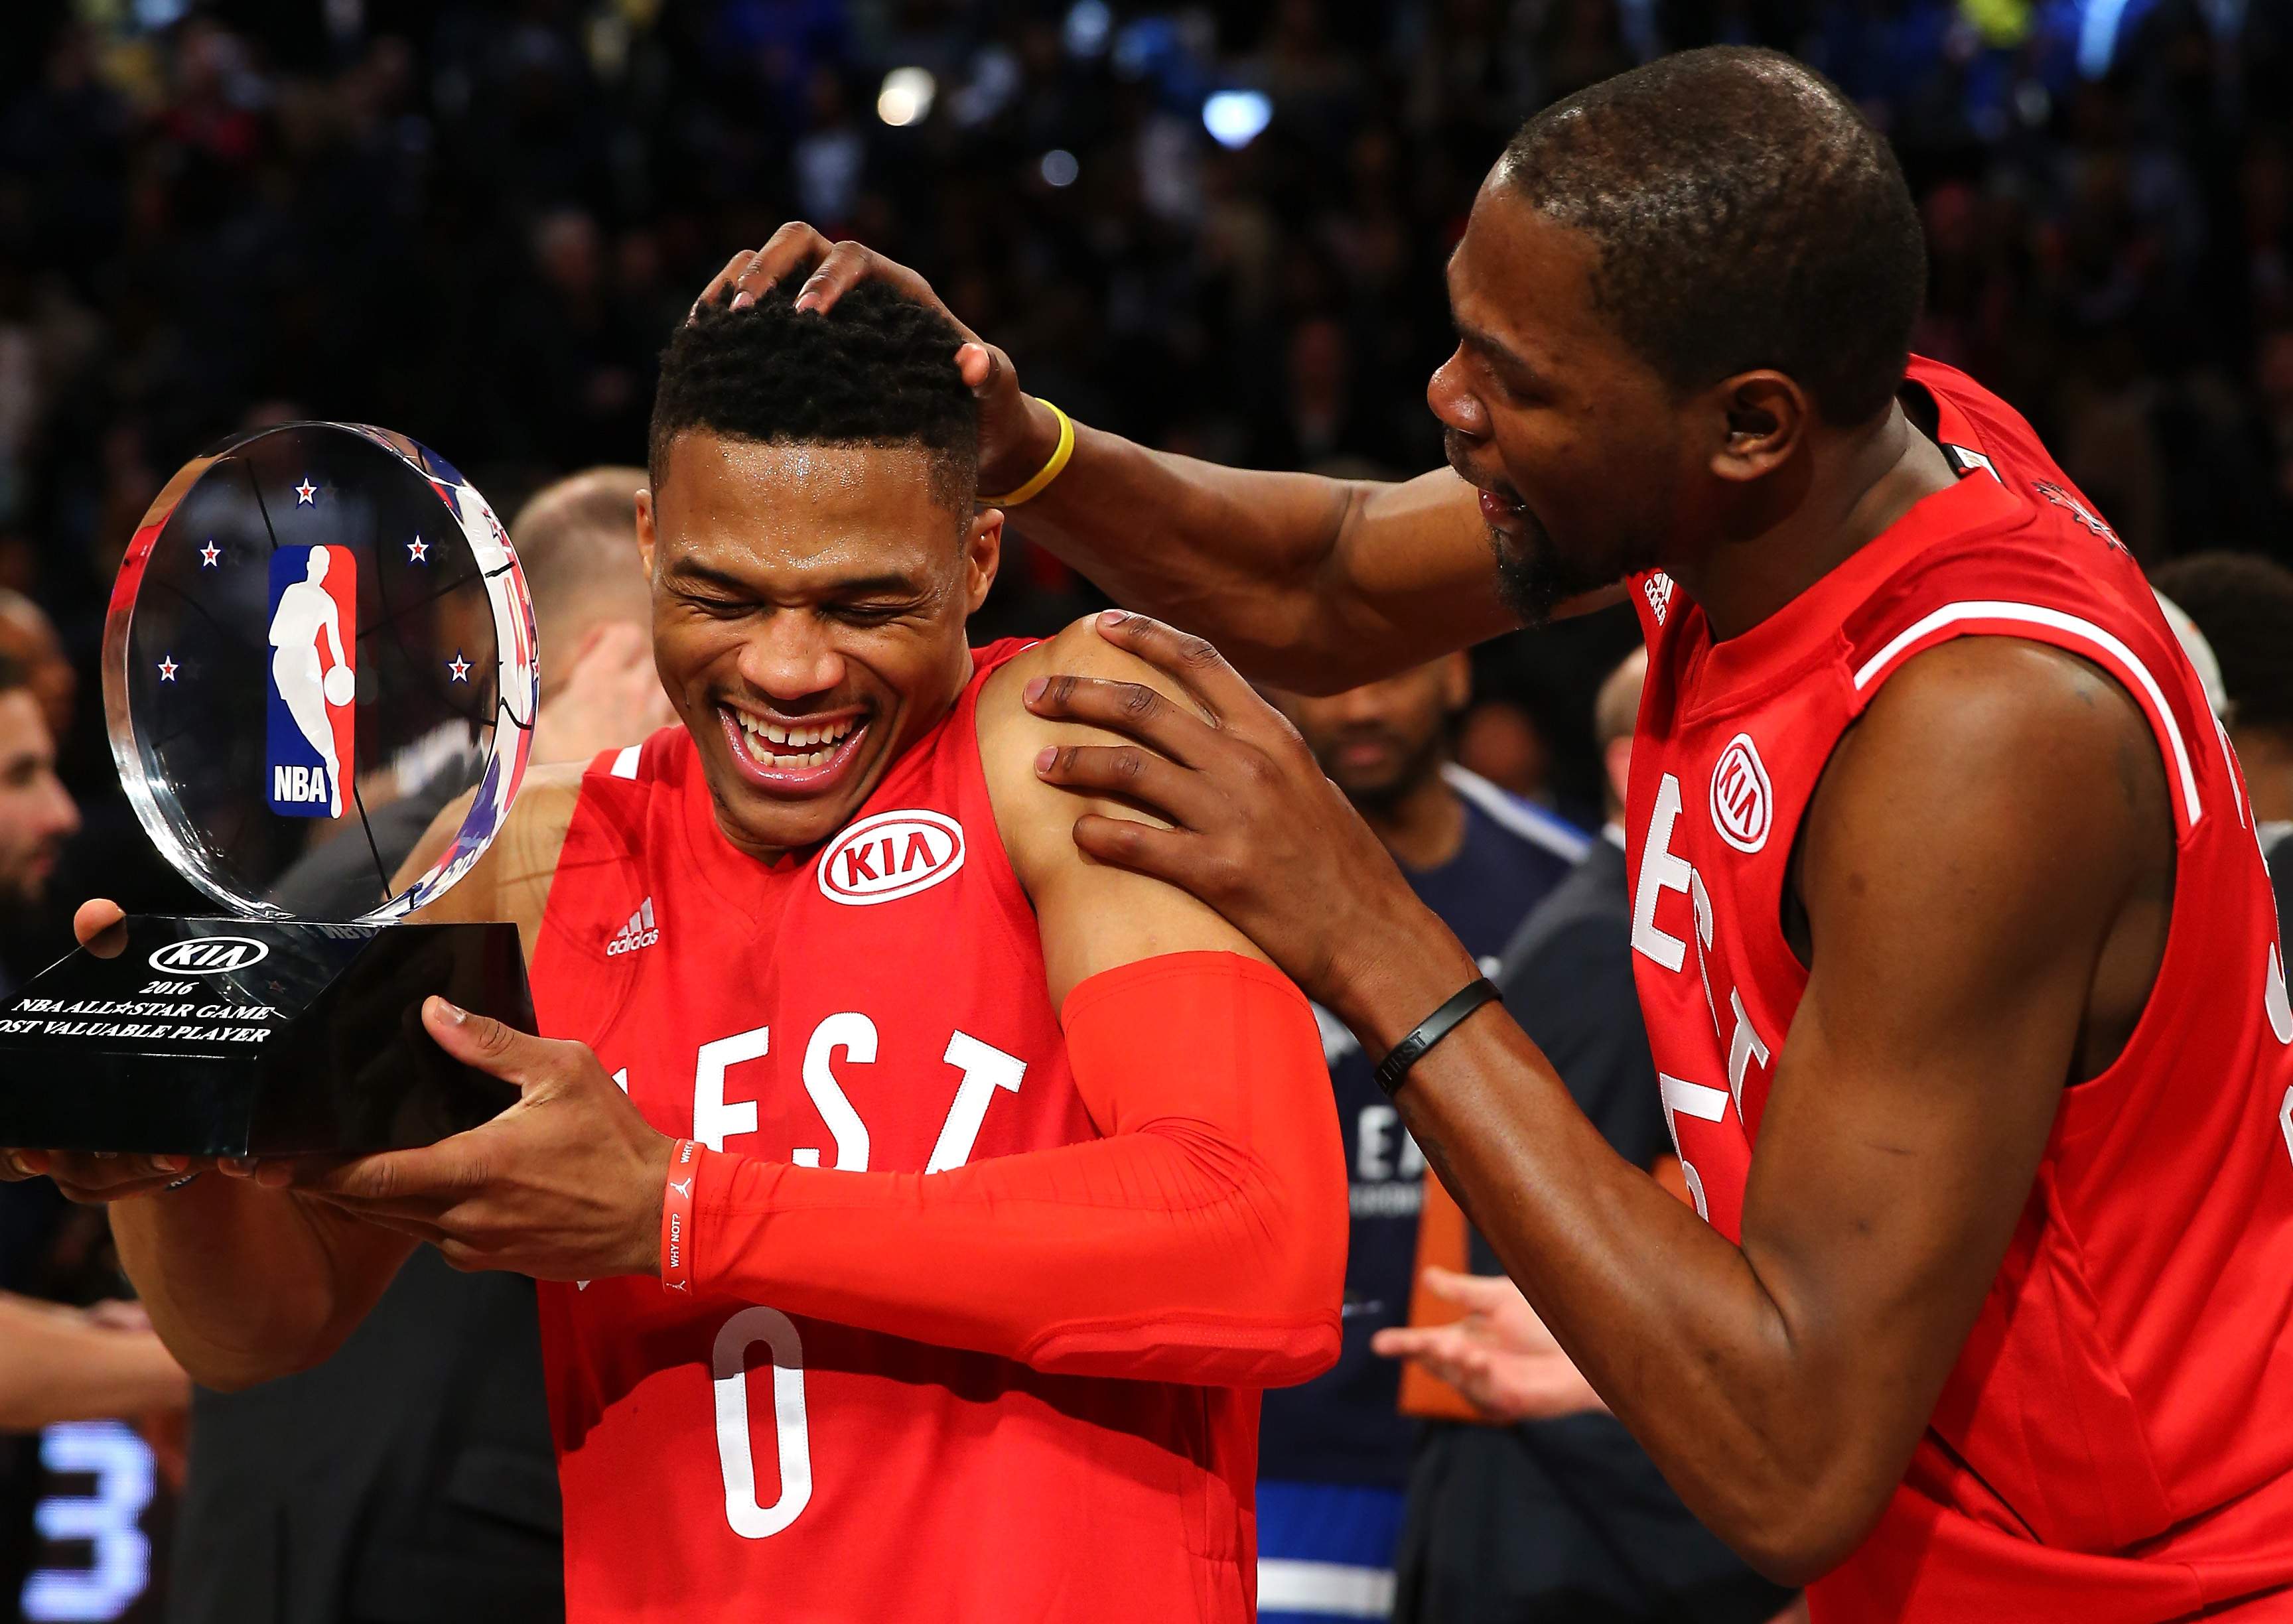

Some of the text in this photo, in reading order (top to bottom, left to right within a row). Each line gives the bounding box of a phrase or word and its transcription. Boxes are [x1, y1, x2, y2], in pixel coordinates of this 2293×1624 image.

[1644, 578, 1667, 627] adidas
[273, 765, 328, 803] NBA
[1719, 750, 1757, 835] KIA
[844, 832, 938, 888] KIA
[163, 944, 249, 967] KIA
[606, 928, 660, 957] adidas
[11, 998, 64, 1012] NBA
[196, 1004, 276, 1020] GAME
[139, 981, 200, 995] 2016
[0, 1019, 272, 1043] OST VALUABLE PLAYER
[612, 1011, 1028, 1176] EST
[680, 1144, 693, 1164] WHY
[670, 1213, 681, 1268] WHY NOT?
[712, 1306, 813, 1539] 0
[19, 1418, 157, 1623] 3
